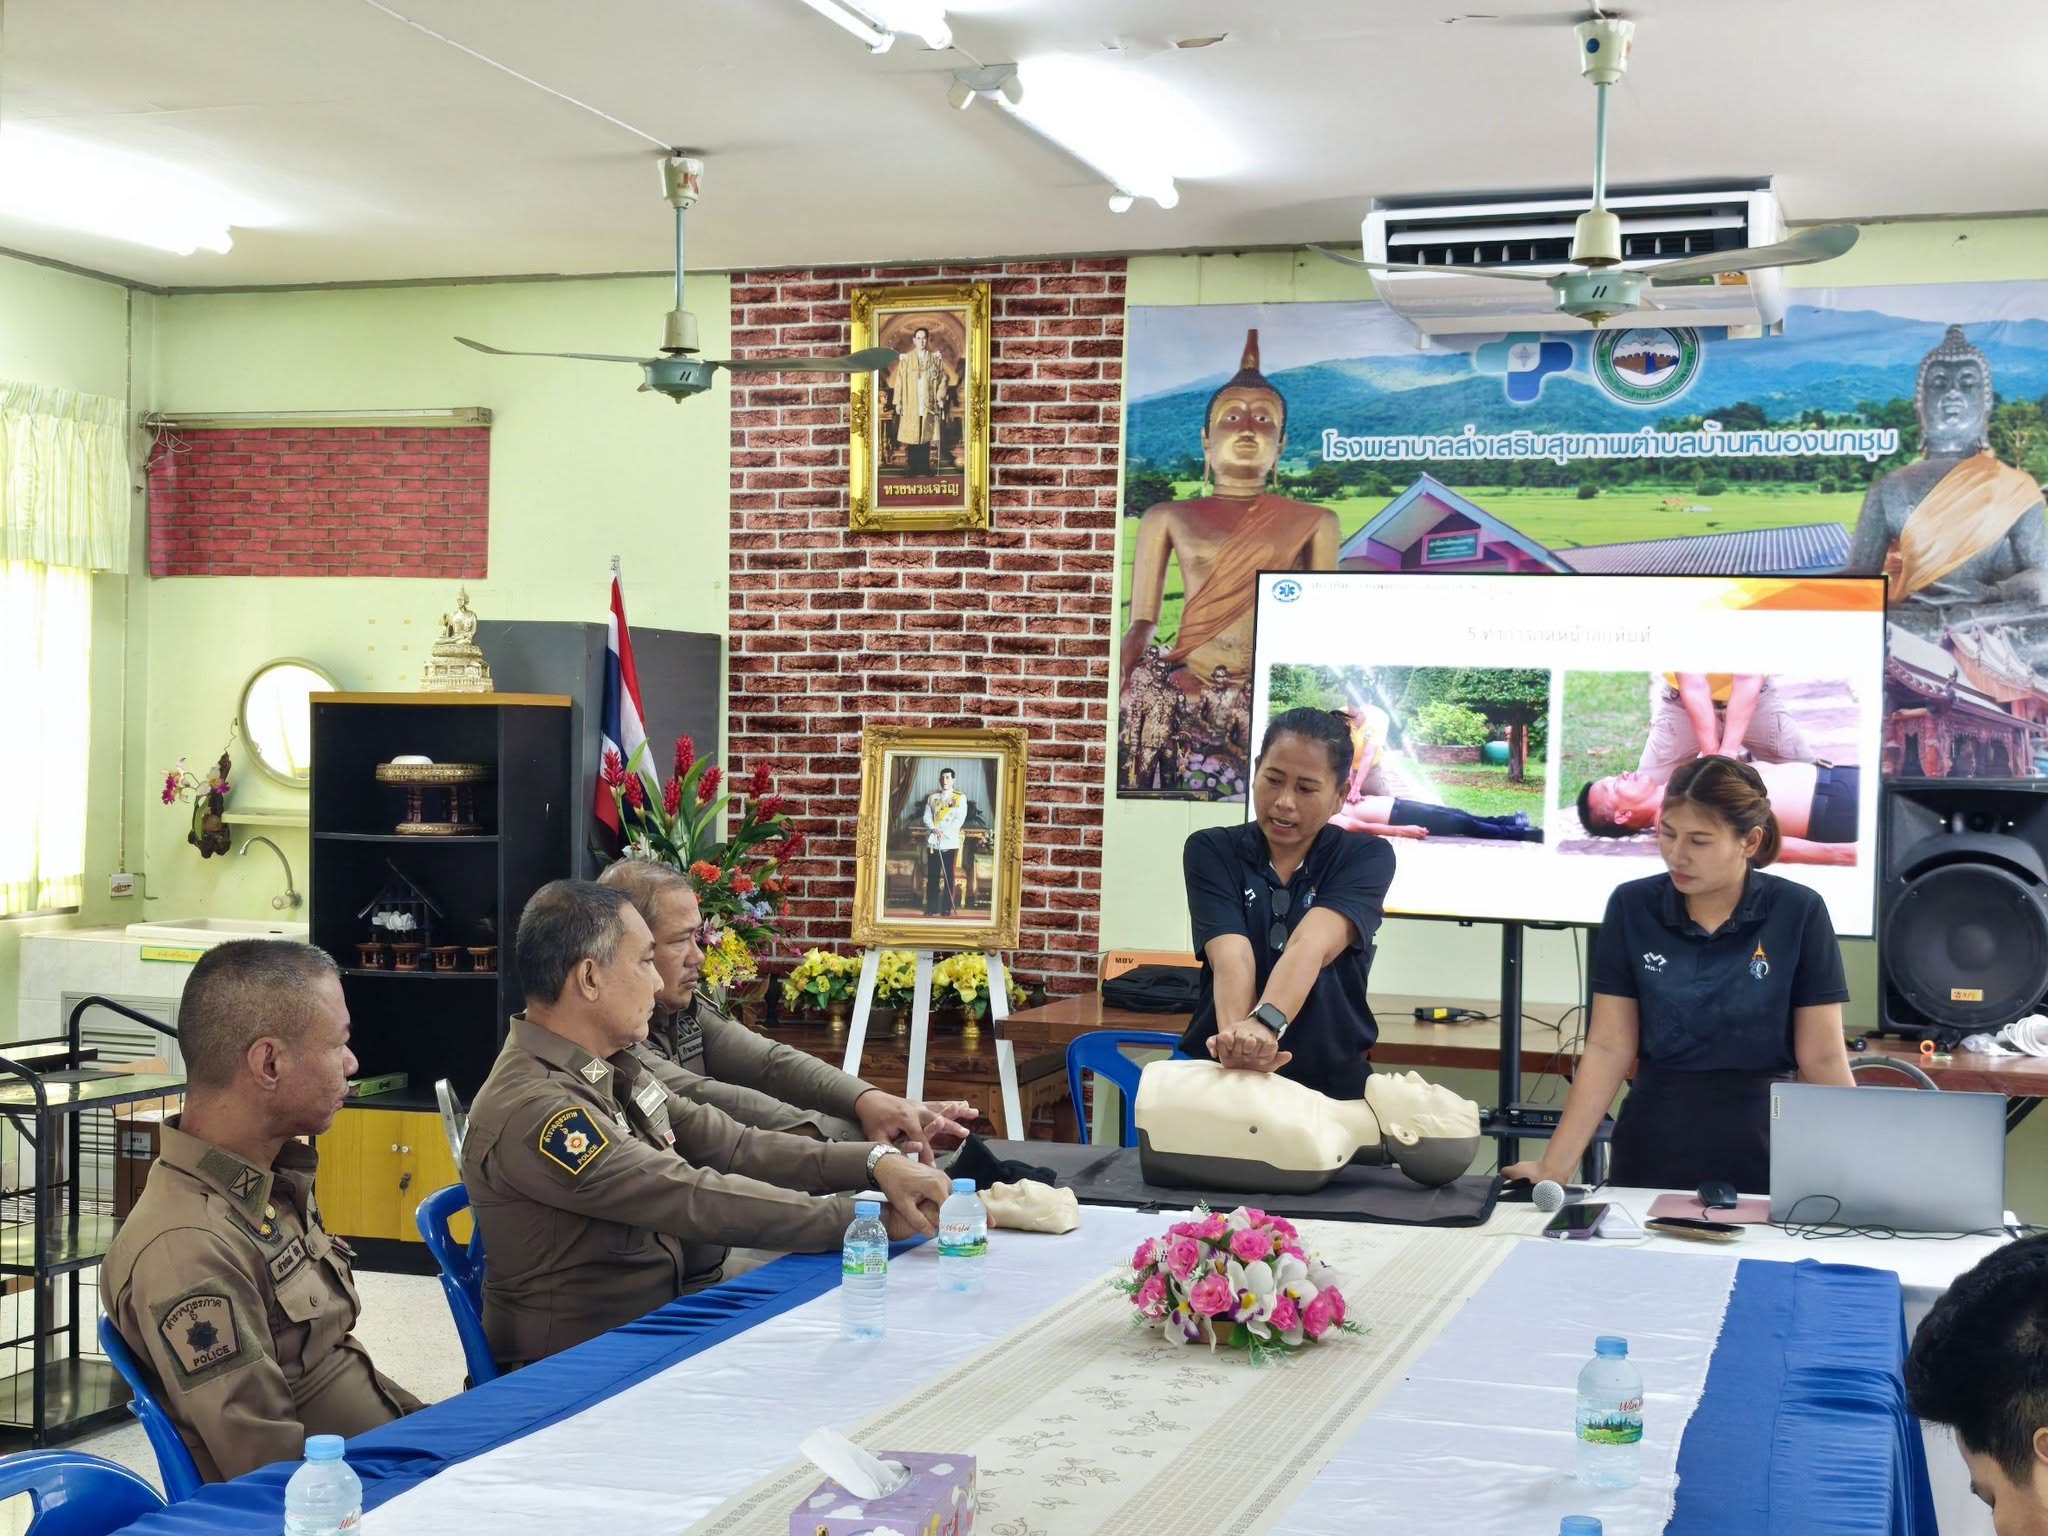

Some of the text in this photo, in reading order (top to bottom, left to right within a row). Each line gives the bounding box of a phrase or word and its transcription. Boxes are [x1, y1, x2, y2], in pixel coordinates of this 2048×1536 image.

[1324, 421, 1896, 464] โรงพยาบาลส่งเสริมสุขภาพตำบลบ้านหนองนกชุม
[883, 480, 959, 496] ทรงพระเจริญ
[577, 1144, 599, 1165] POLICE
[193, 1344, 231, 1367] POLICE
